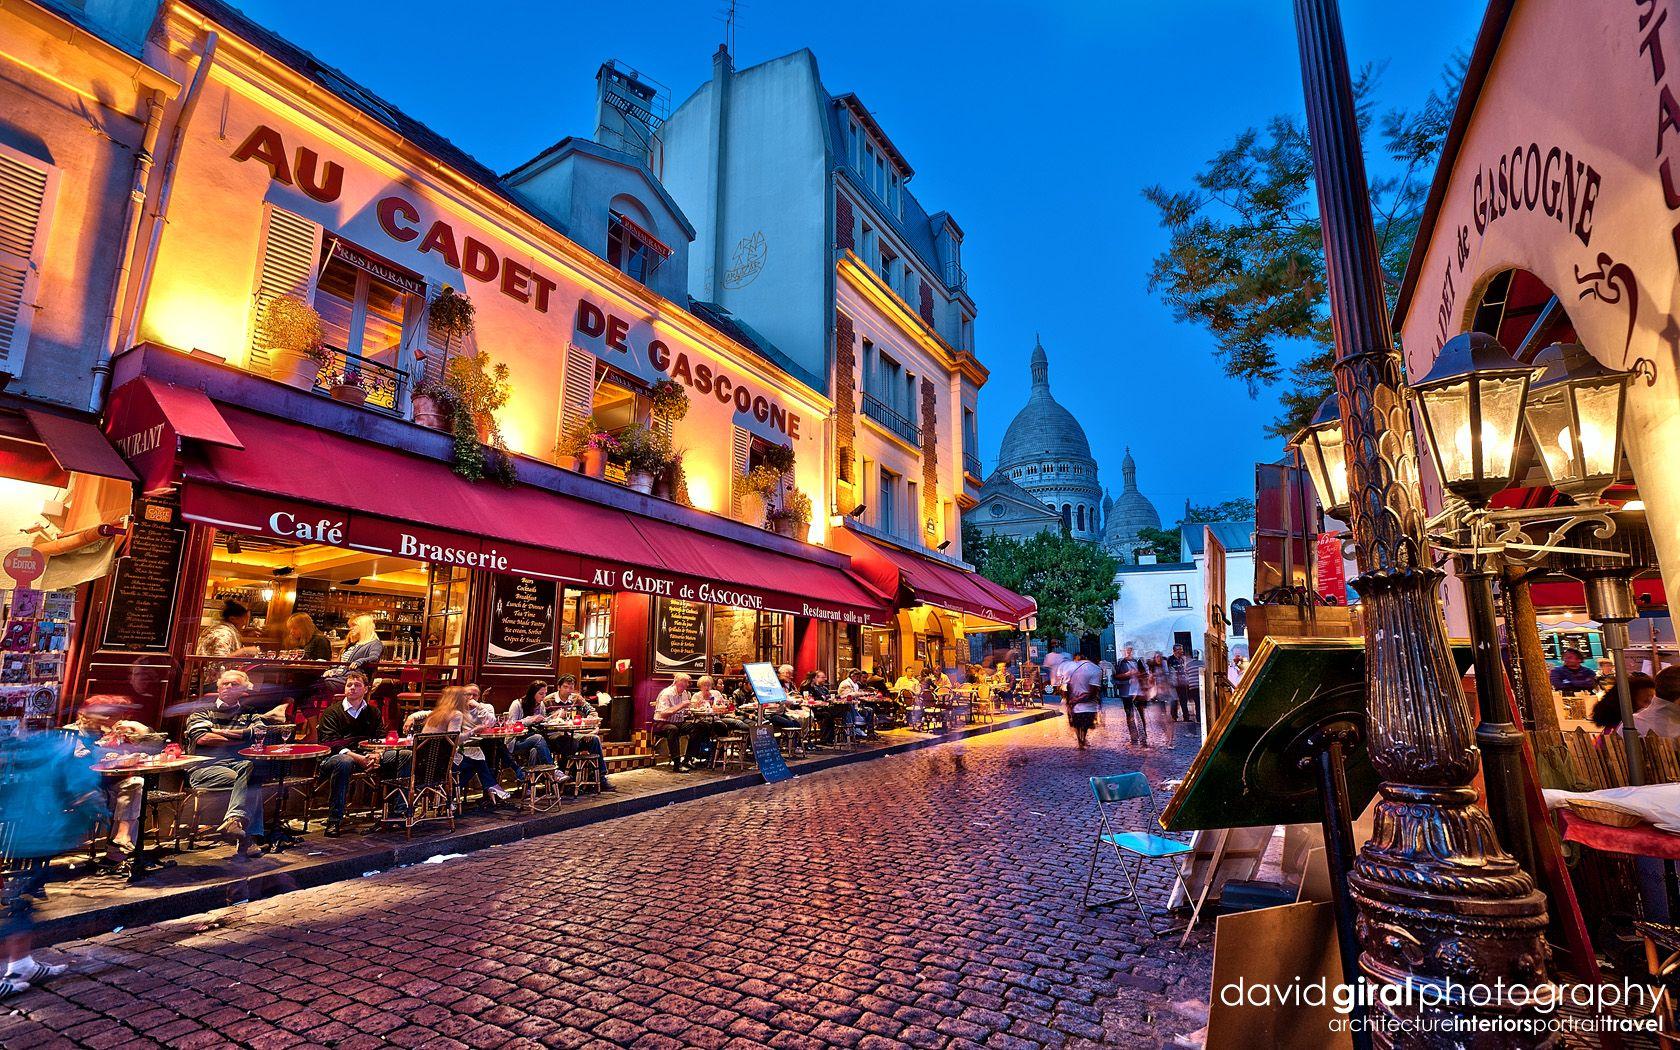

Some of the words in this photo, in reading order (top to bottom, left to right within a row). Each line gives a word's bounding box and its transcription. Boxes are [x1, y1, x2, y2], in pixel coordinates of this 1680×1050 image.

[624, 220, 668, 256] RESTAURANT
[1457, 224, 1470, 273] de
[1473, 142, 1602, 247] GASCOGNE
[229, 125, 345, 203] AU
[376, 196, 557, 313] CADET
[577, 298, 629, 354] DE
[647, 339, 801, 440] GASCOGNE
[341, 250, 422, 292] RESTAURANT
[13, 558, 37, 570] EDITOR
[269, 511, 343, 545] Café
[398, 533, 508, 571] Brasserie
[592, 569, 615, 587] AU
[622, 570, 674, 596] CADET
[679, 585, 694, 599] de
[699, 583, 763, 609] GASCOGNE
[802, 603, 842, 621] Restaurant
[843, 611, 857, 623] salle
